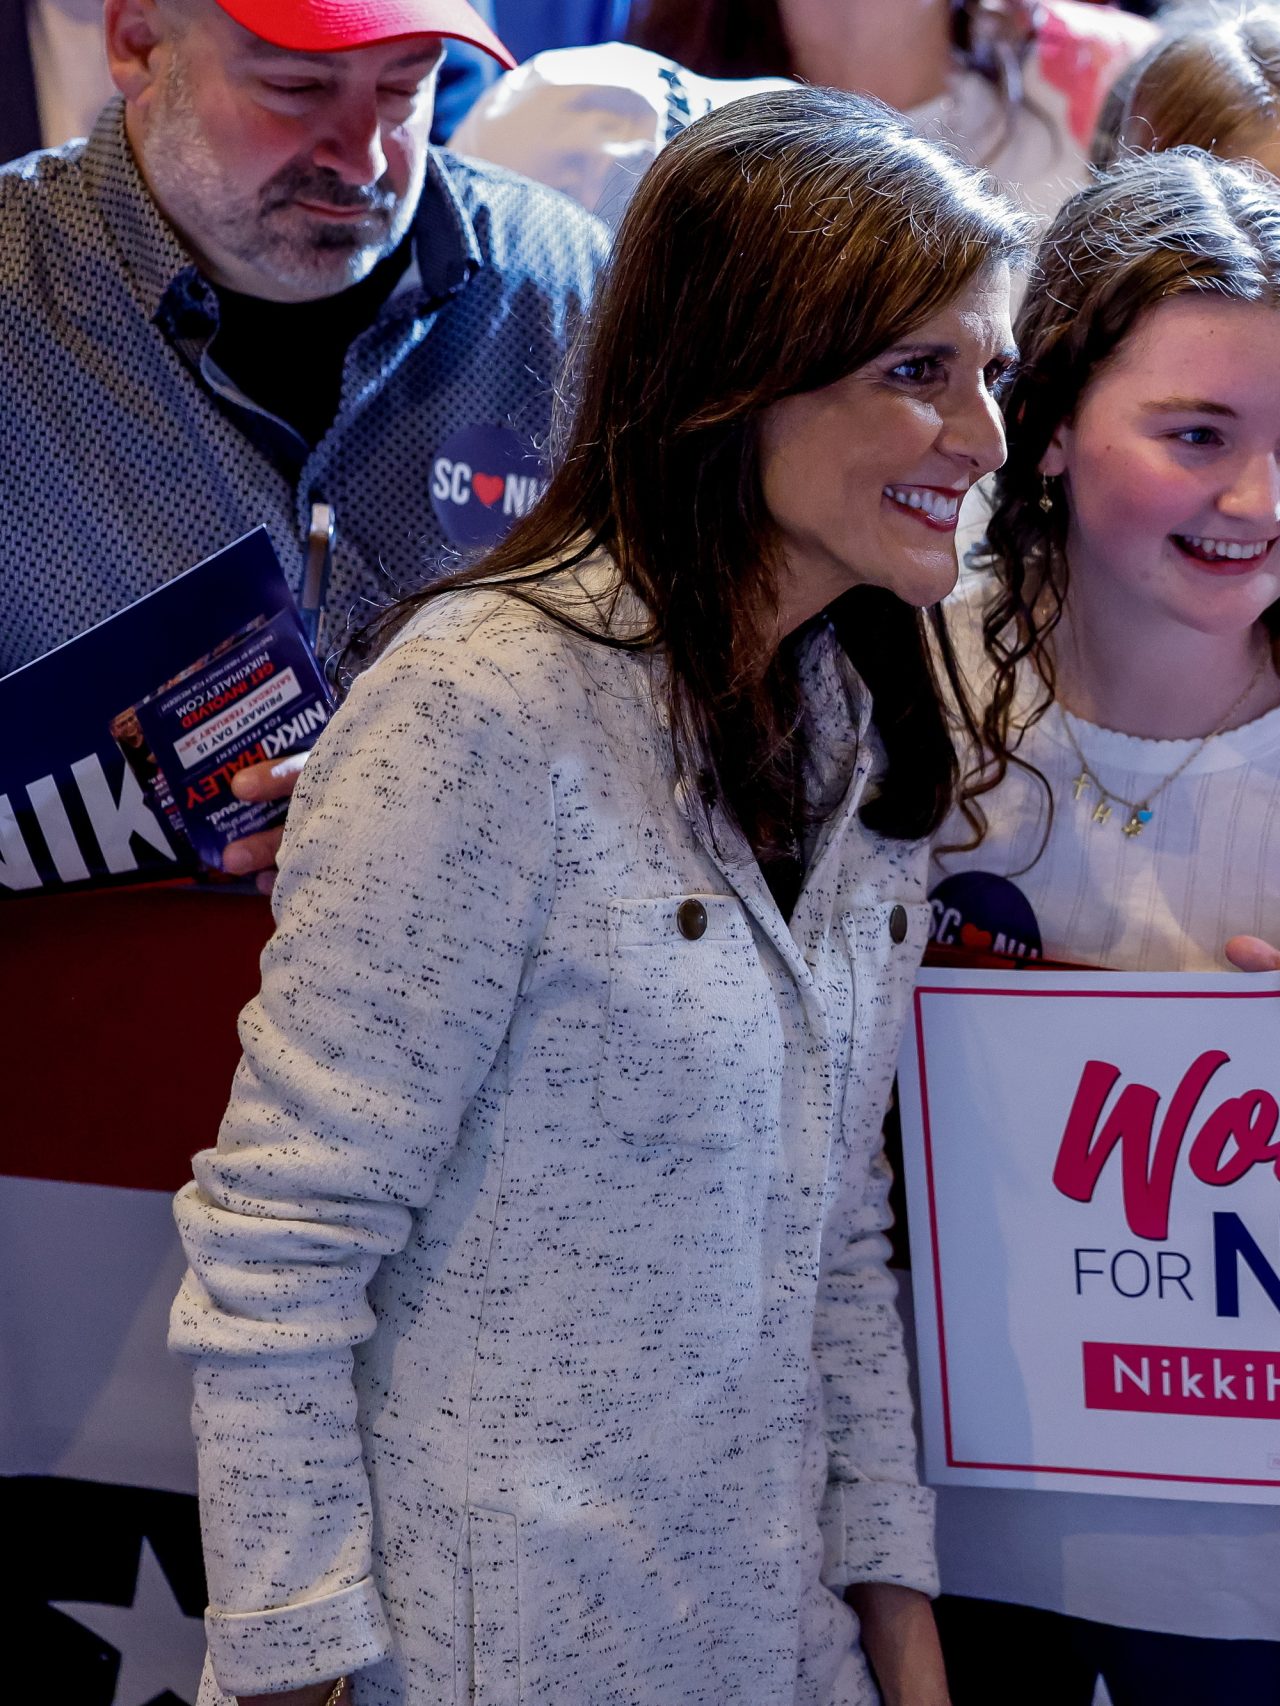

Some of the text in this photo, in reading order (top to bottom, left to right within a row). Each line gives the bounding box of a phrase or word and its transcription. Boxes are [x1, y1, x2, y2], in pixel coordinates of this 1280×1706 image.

[433, 457, 472, 505] SC
[175, 651, 271, 719] NIKKIHALEY.COM
[179, 661, 276, 730] GET INVOLVED
[196, 691, 285, 755] PRIMARY DAY IS
[213, 727, 263, 764] PRESIDENT
[1073, 1248, 1194, 1301] FOR
